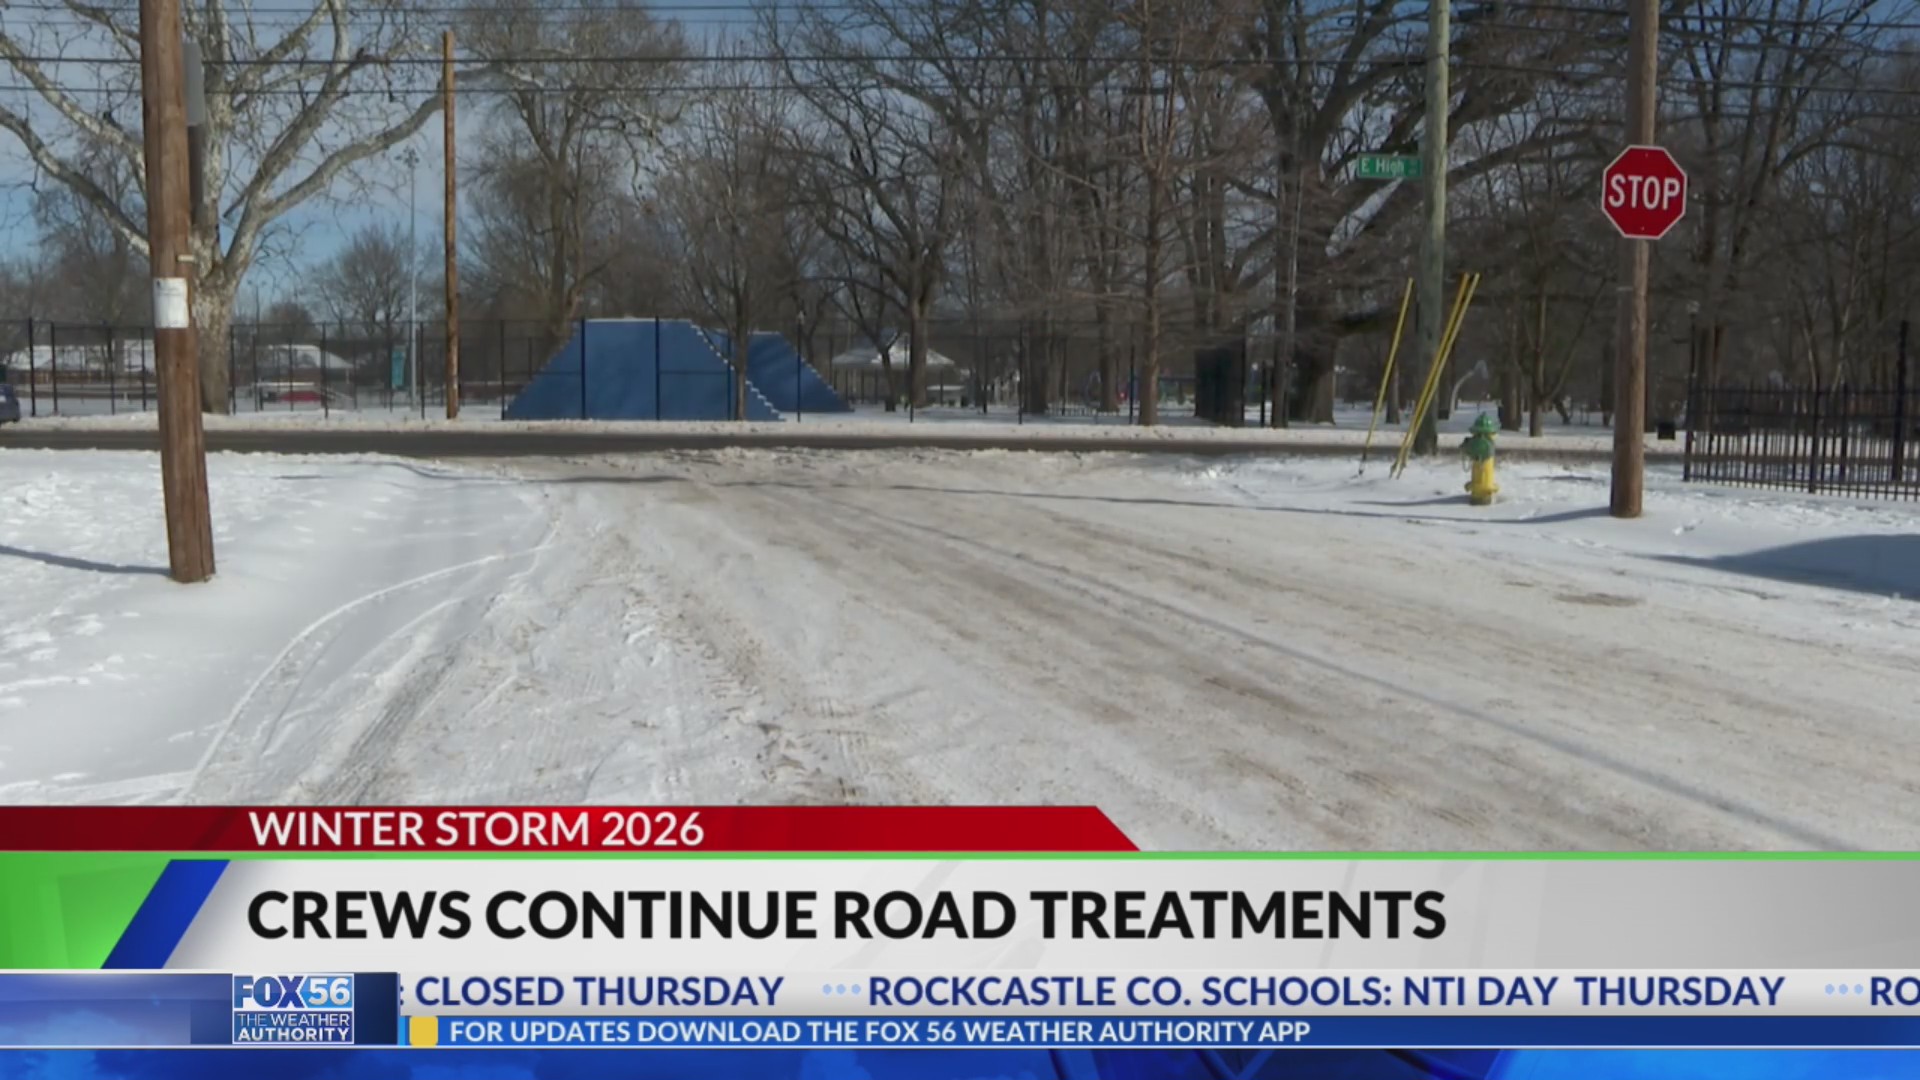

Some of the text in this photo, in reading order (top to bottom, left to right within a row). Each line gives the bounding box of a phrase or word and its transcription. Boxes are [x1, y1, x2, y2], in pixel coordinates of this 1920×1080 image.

[1361, 157, 1370, 173] E
[1375, 157, 1405, 177] High
[1607, 173, 1681, 211] STOP
